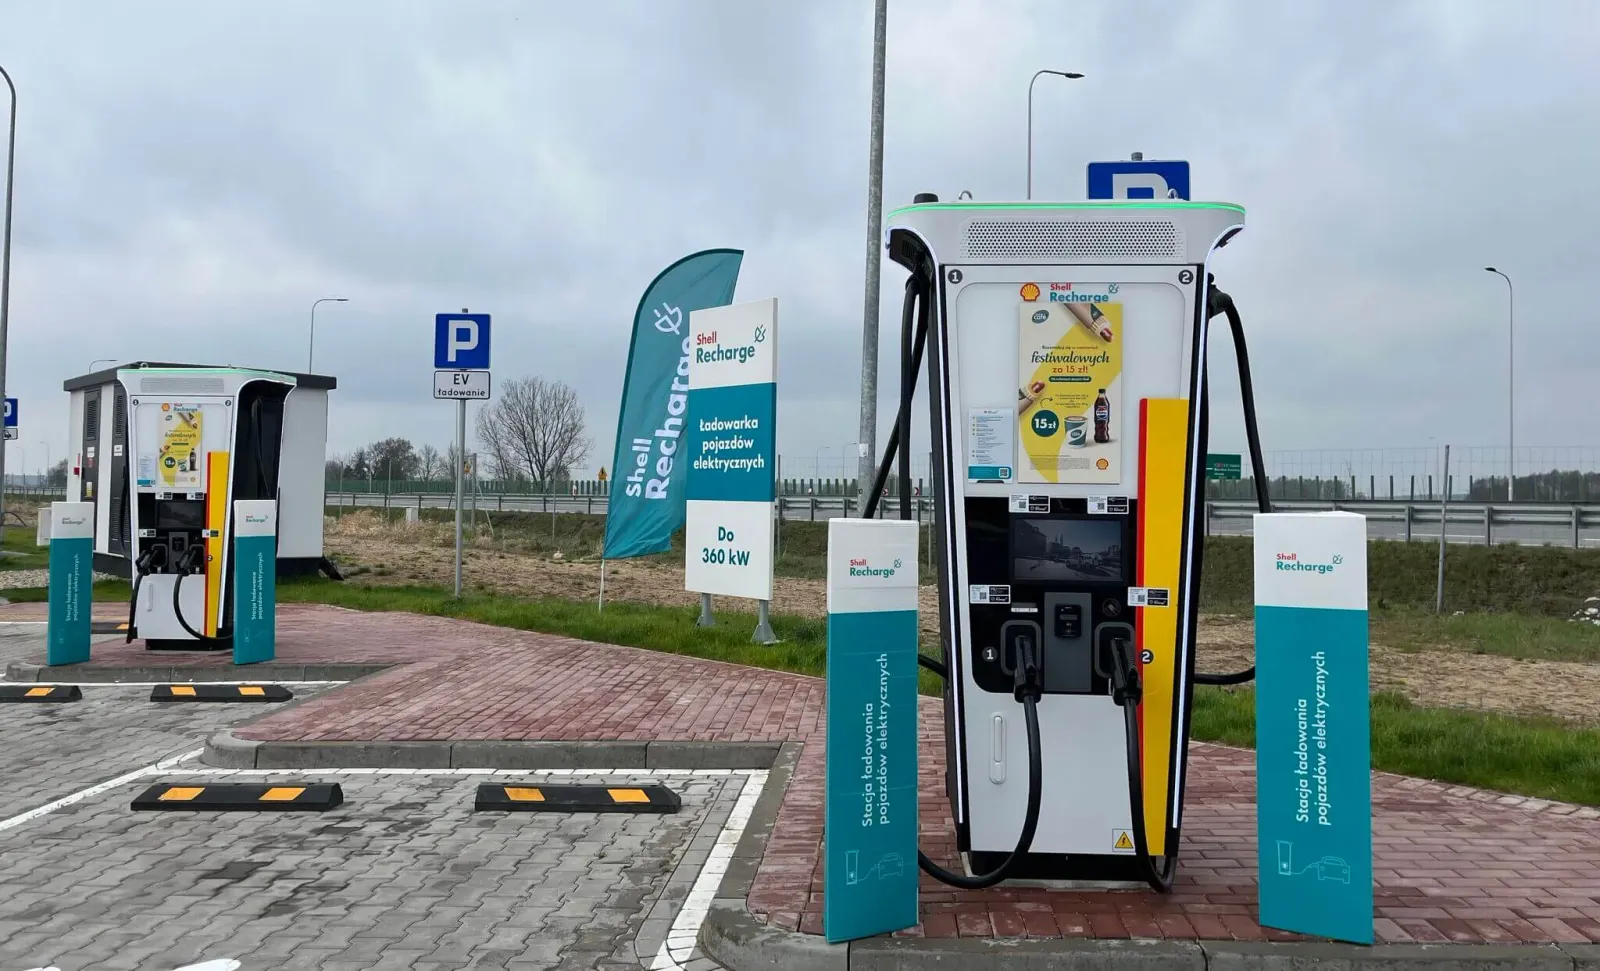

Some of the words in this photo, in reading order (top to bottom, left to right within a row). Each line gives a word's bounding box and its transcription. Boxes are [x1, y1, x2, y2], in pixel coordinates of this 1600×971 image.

[951, 271, 960, 283] 1
[1181, 271, 1191, 283] 2
[1050, 282, 1072, 291] Shell
[1049, 291, 1109, 303] Recharge
[447, 319, 479, 362] P
[696, 331, 717, 345] Shell
[696, 344, 755, 363] Recharge
[1031, 351, 1110, 366] festiwalowych
[1066, 365, 1075, 374] 15
[453, 373, 470, 385] EV
[437, 388, 486, 397] ładowanie
[700, 415, 758, 431] Ładowarka
[1034, 418, 1048, 429] 15
[1048, 420, 1056, 429] zł
[702, 435, 754, 454] pojazdów
[625, 438, 652, 498] Shell
[693, 454, 764, 472] elektrycznych
[718, 526, 734, 542] Do
[702, 547, 725, 564] 360
[729, 548, 750, 566] kW
[850, 566, 895, 578] Recharge
[1276, 561, 1334, 574] Recharge
[986, 649, 994, 660] 1
[1142, 651, 1150, 663] 2
[876, 653, 891, 750] elektrycznych
[1311, 651, 1329, 749] elektrycznych
[861, 703, 874, 780] ładowania
[1293, 699, 1308, 774] ładowania
[877, 754, 891, 826] pojazdów
[1313, 753, 1331, 826] pojazdów
[862, 781, 876, 827] Stacja
[1295, 780, 1312, 823] Stacja
